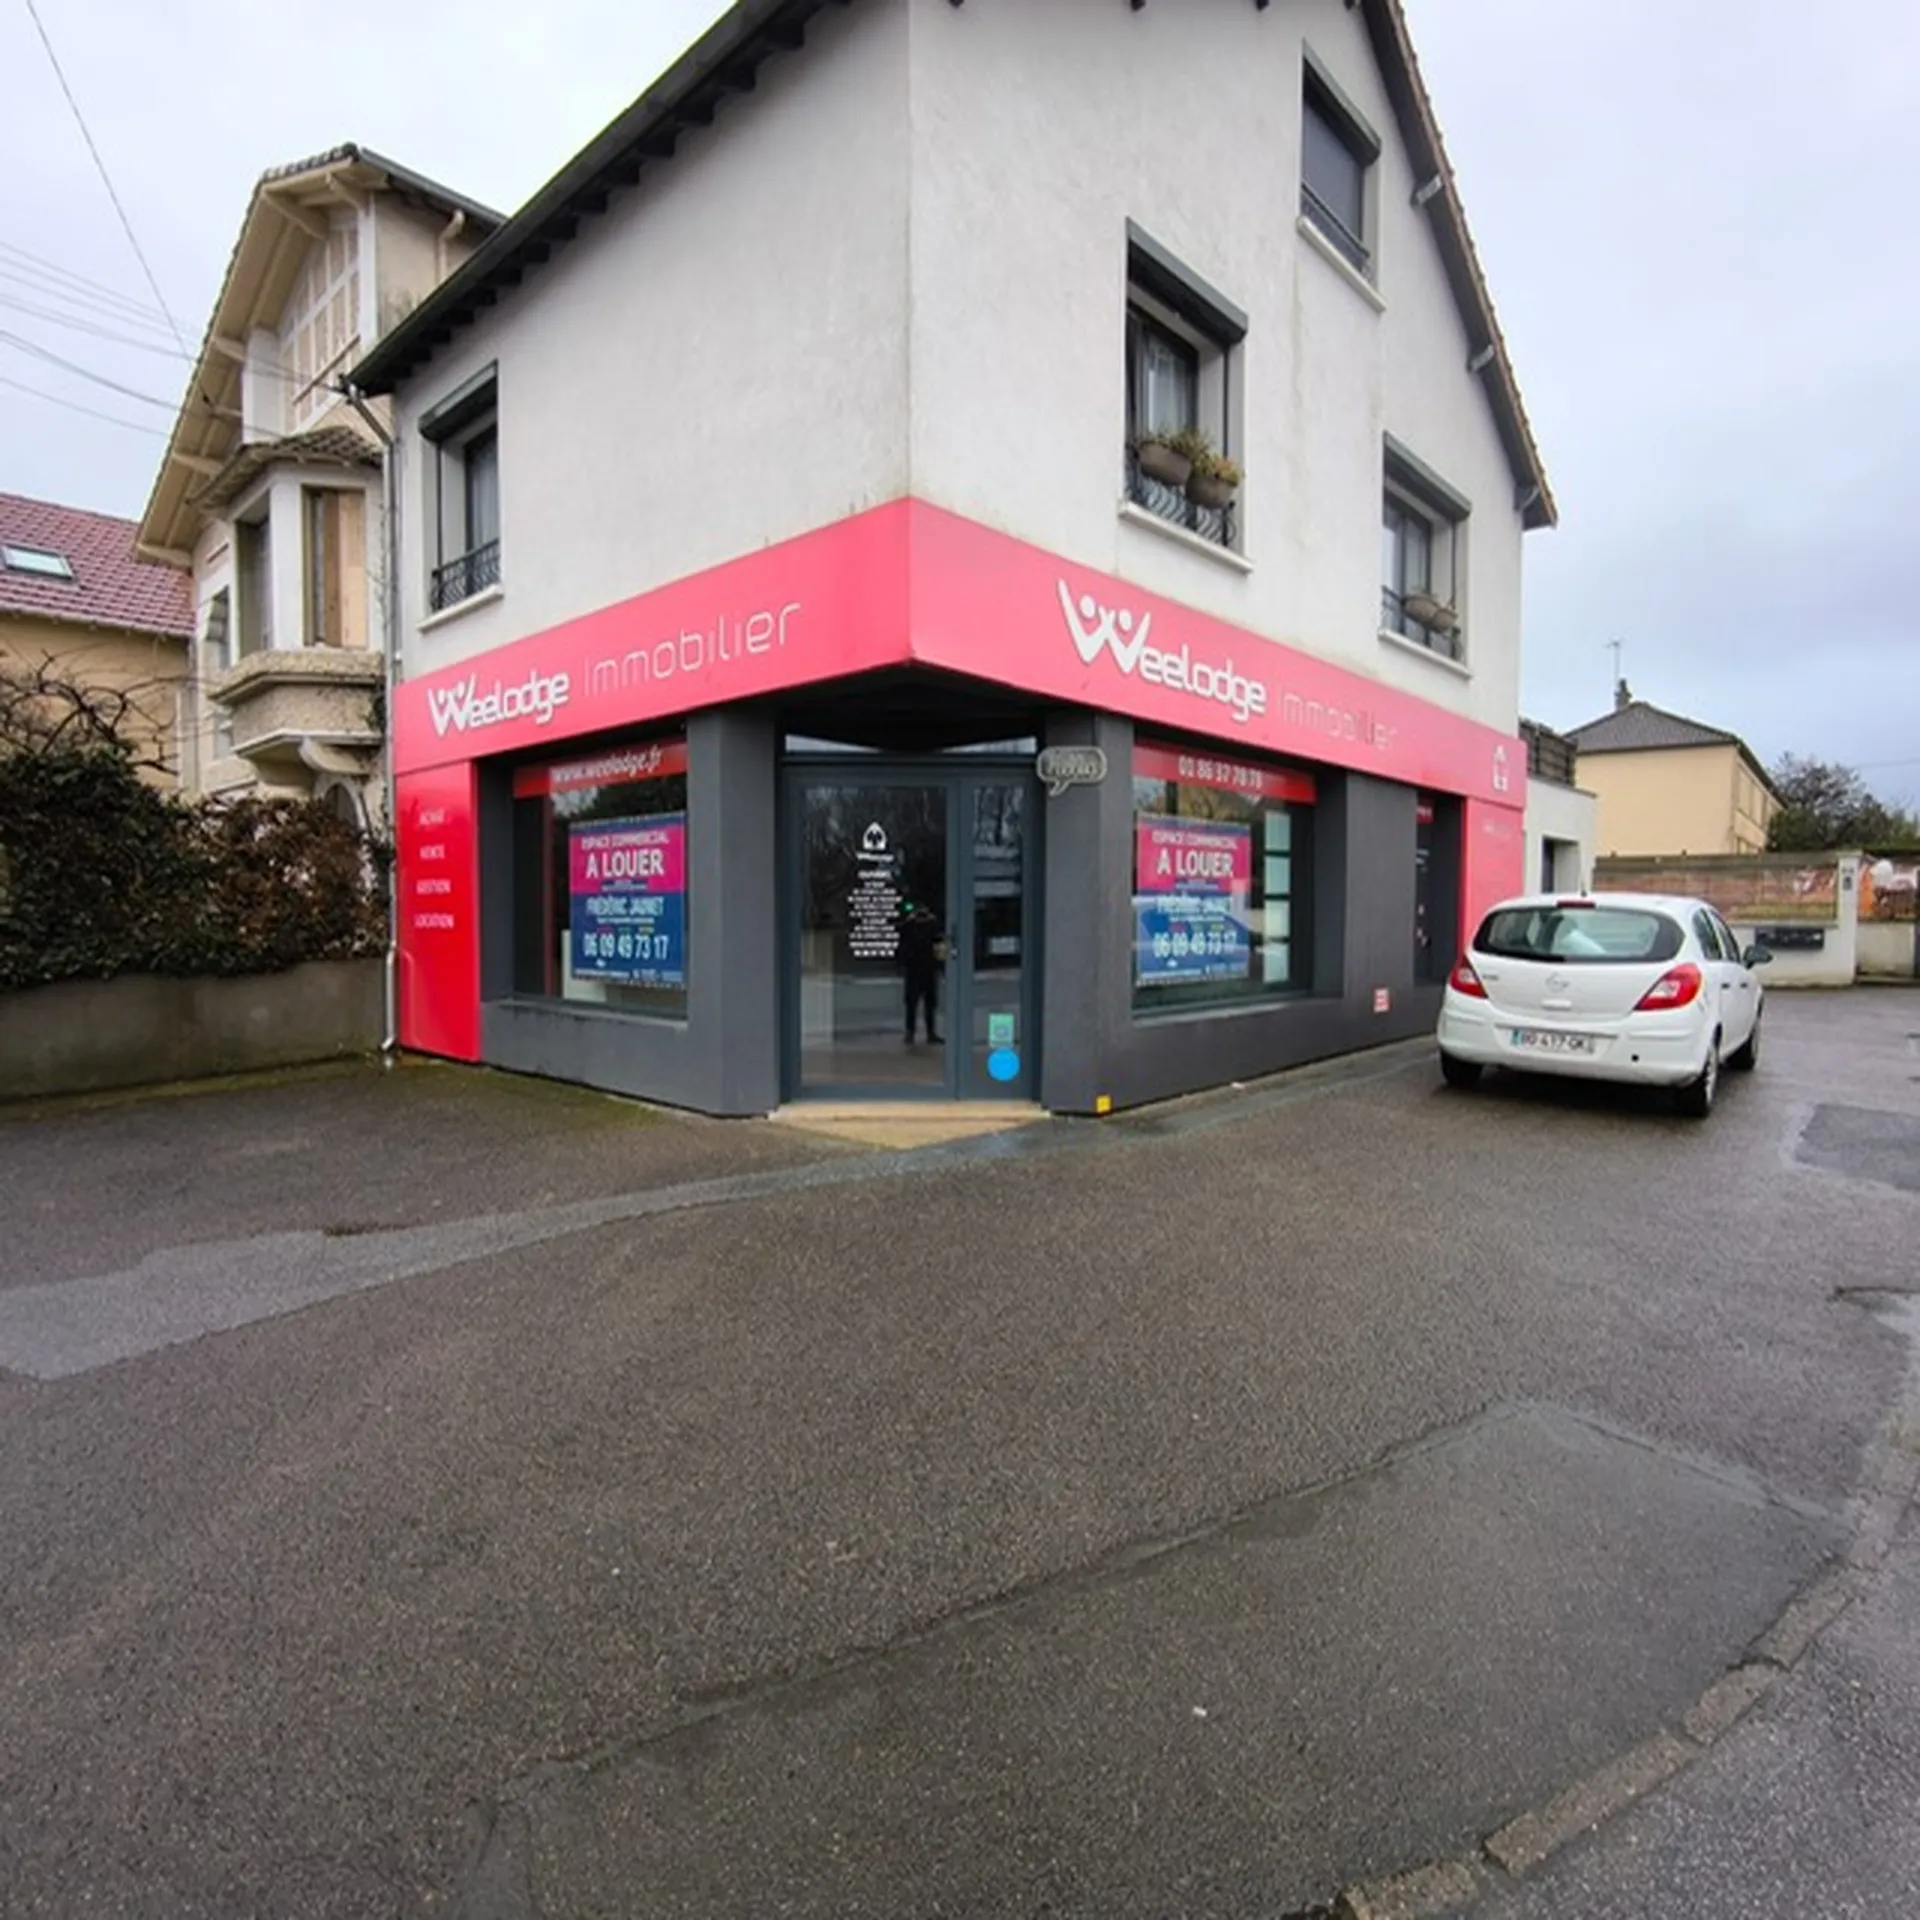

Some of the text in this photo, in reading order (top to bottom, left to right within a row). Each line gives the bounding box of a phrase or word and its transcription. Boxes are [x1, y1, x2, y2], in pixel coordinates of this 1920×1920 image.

[1057, 578, 1268, 722] Weelodge
[427, 601, 801, 738] Weelodge Immobilier
[601, 849, 666, 878] LOUER
[1175, 850, 1235, 878] LOUER
[653, 935, 669, 961] 17
